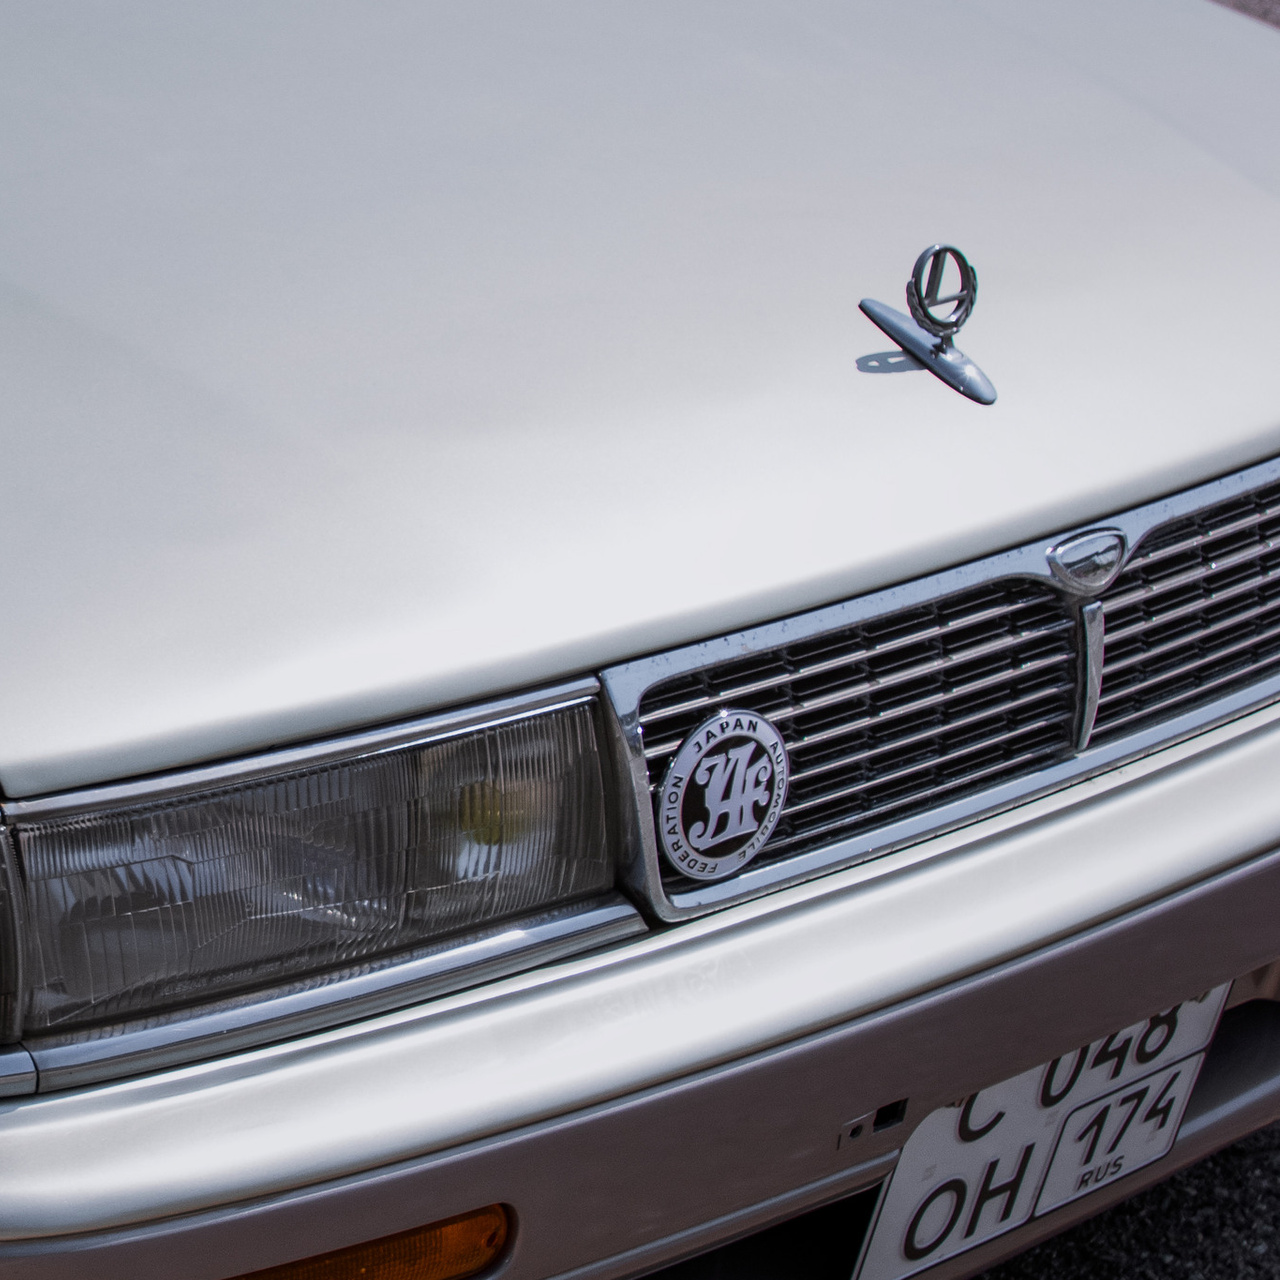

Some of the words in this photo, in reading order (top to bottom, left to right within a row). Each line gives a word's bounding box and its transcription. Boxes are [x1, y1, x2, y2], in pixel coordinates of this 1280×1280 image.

[692, 718, 758, 753] JAPAN
[666, 776, 719, 874] FEDERATION
[738, 741, 785, 862] AUTOMOBILE
[1075, 1070, 1181, 1166] 174
[904, 1143, 1036, 1261] OH
[1077, 1155, 1124, 1191] RUS
